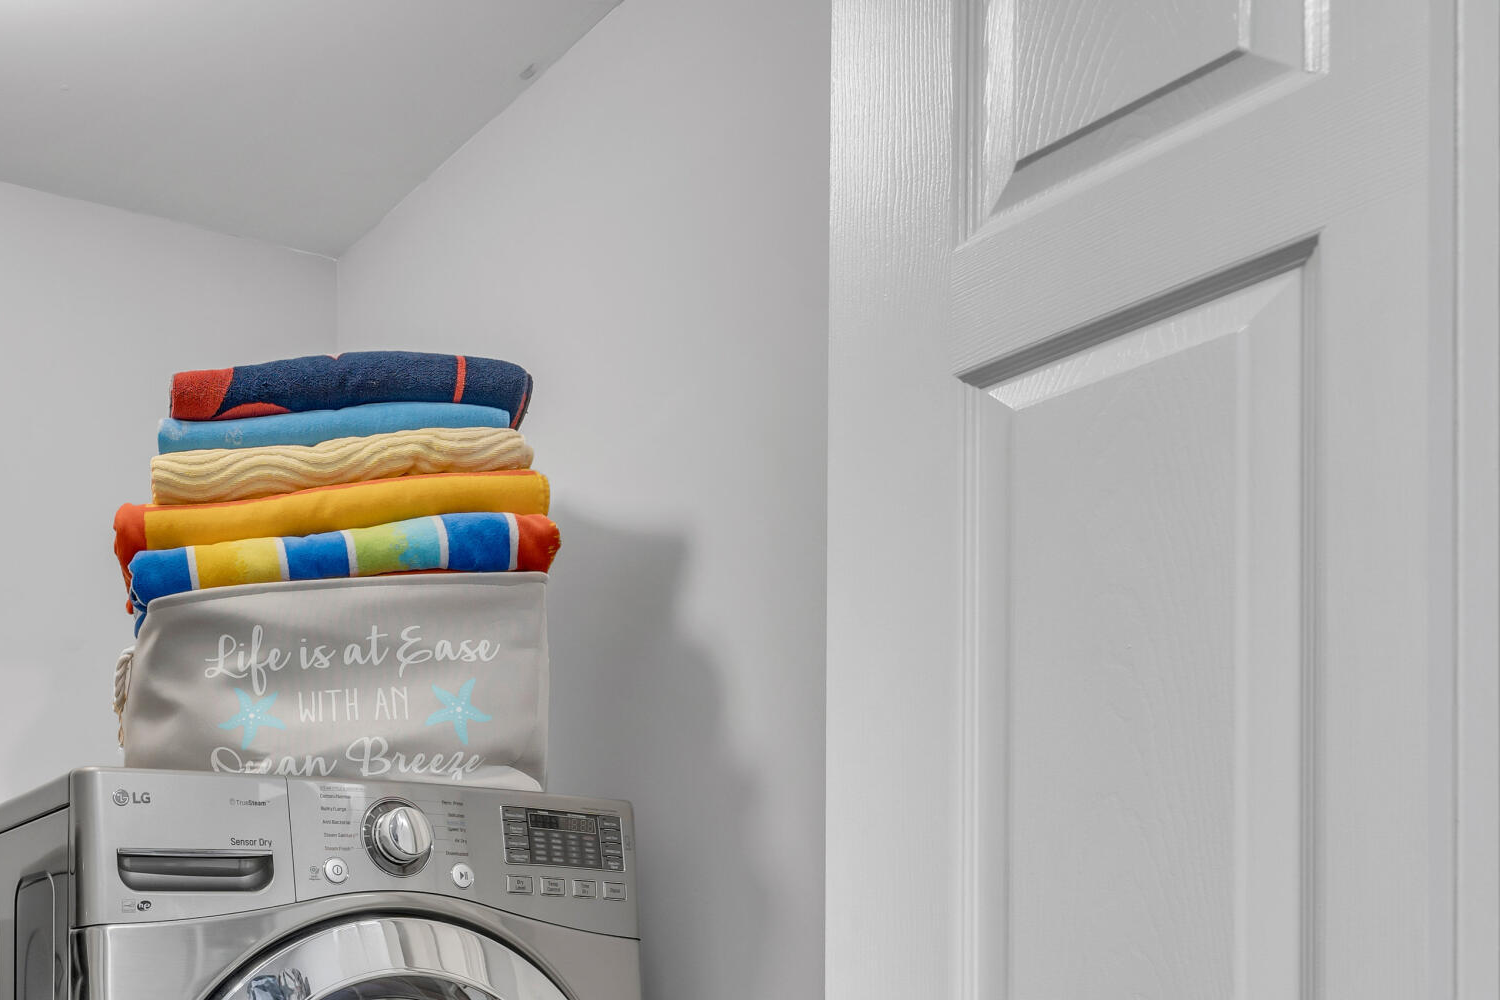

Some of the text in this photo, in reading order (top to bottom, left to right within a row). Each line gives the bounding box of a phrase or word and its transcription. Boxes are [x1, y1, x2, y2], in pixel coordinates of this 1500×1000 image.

[204, 624, 501, 696] Life is at Ease
[298, 686, 410, 723] WITH AN
[210, 736, 486, 781] Ocean Breeze
[132, 791, 152, 804] LG
[230, 837, 273, 848] Sensor Dry
